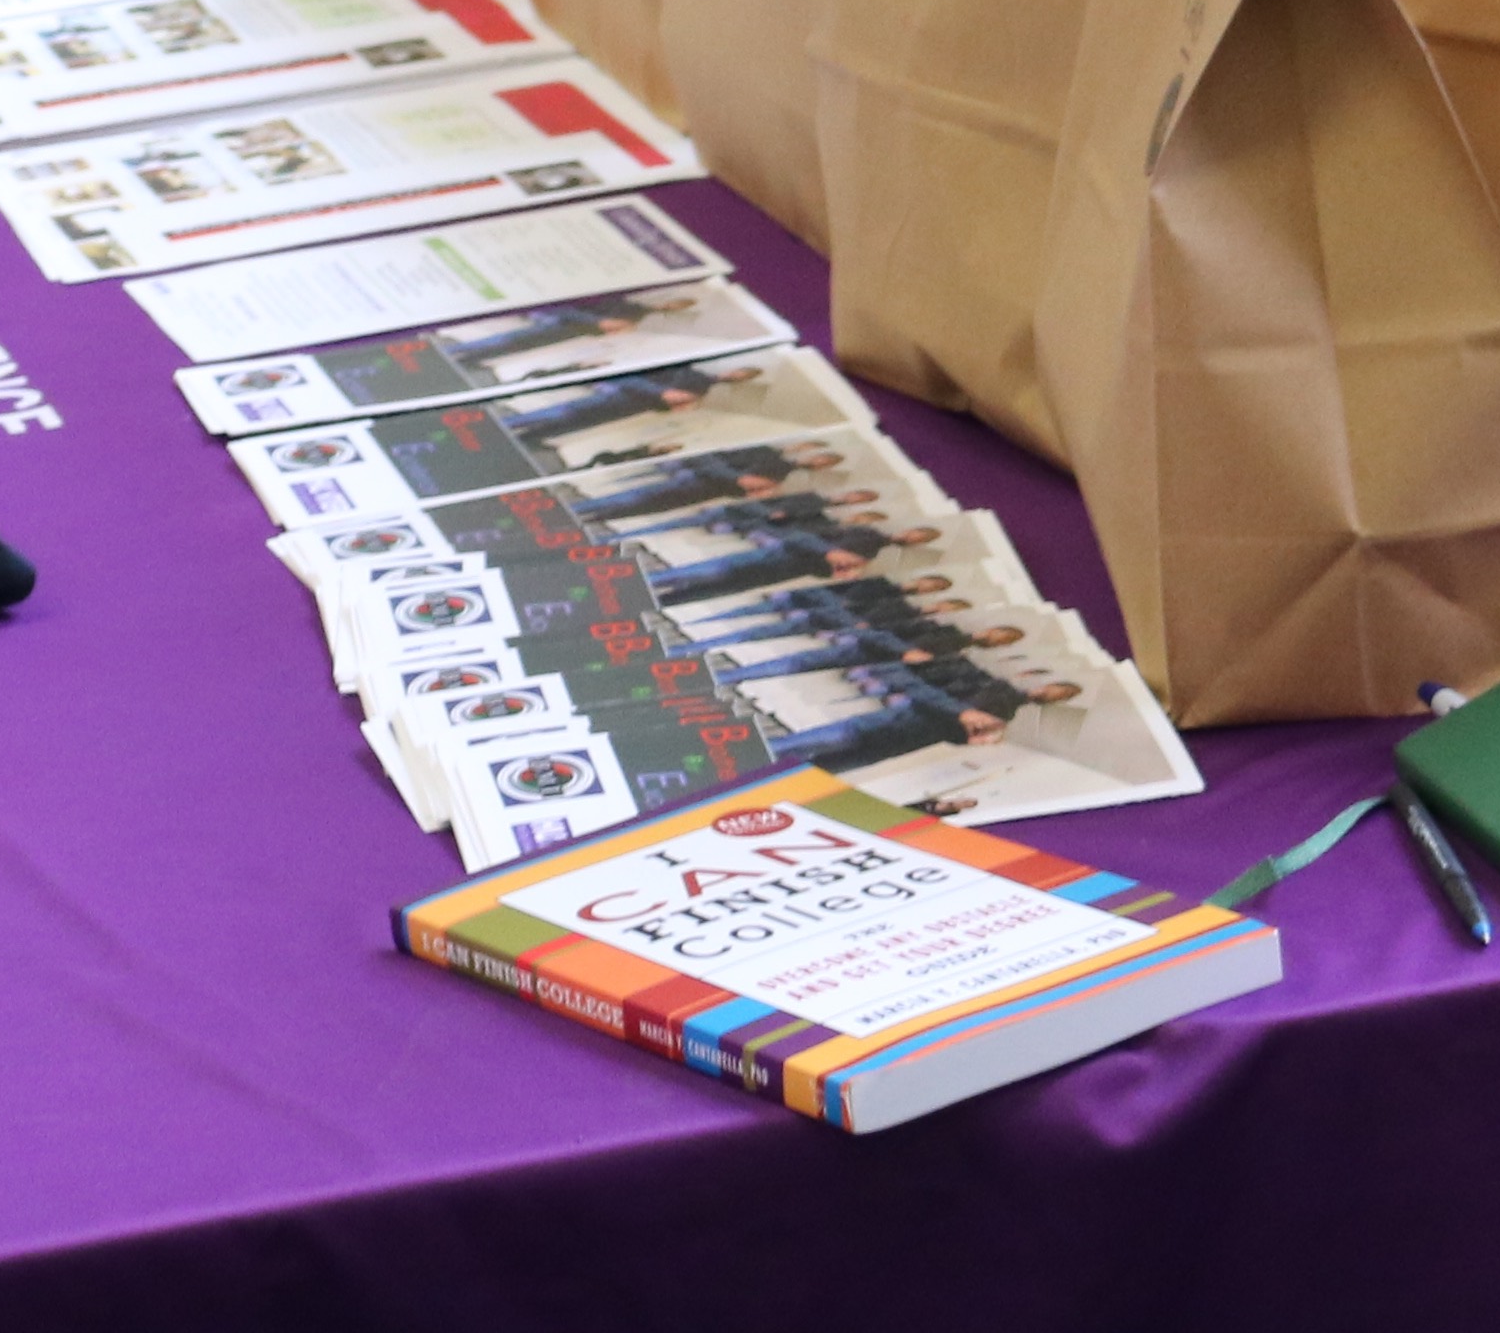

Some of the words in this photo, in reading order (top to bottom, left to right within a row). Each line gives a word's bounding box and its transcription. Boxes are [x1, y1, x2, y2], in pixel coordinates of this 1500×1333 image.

[577, 829, 858, 923] CAN
[624, 847, 902, 944] FINISH
[647, 850, 690, 868] I
[673, 866, 951, 959] College
[787, 979, 840, 1002] AND
[841, 959, 893, 982] GET
[897, 935, 964, 962] YOUR
[964, 904, 1062, 940] DEGREE
[420, 932, 430, 951] I
[432, 935, 470, 969] CAN
[470, 948, 534, 994] FINISH
[535, 979, 625, 1029] COLLEGE
[638, 1019, 673, 1048] MARCIA
